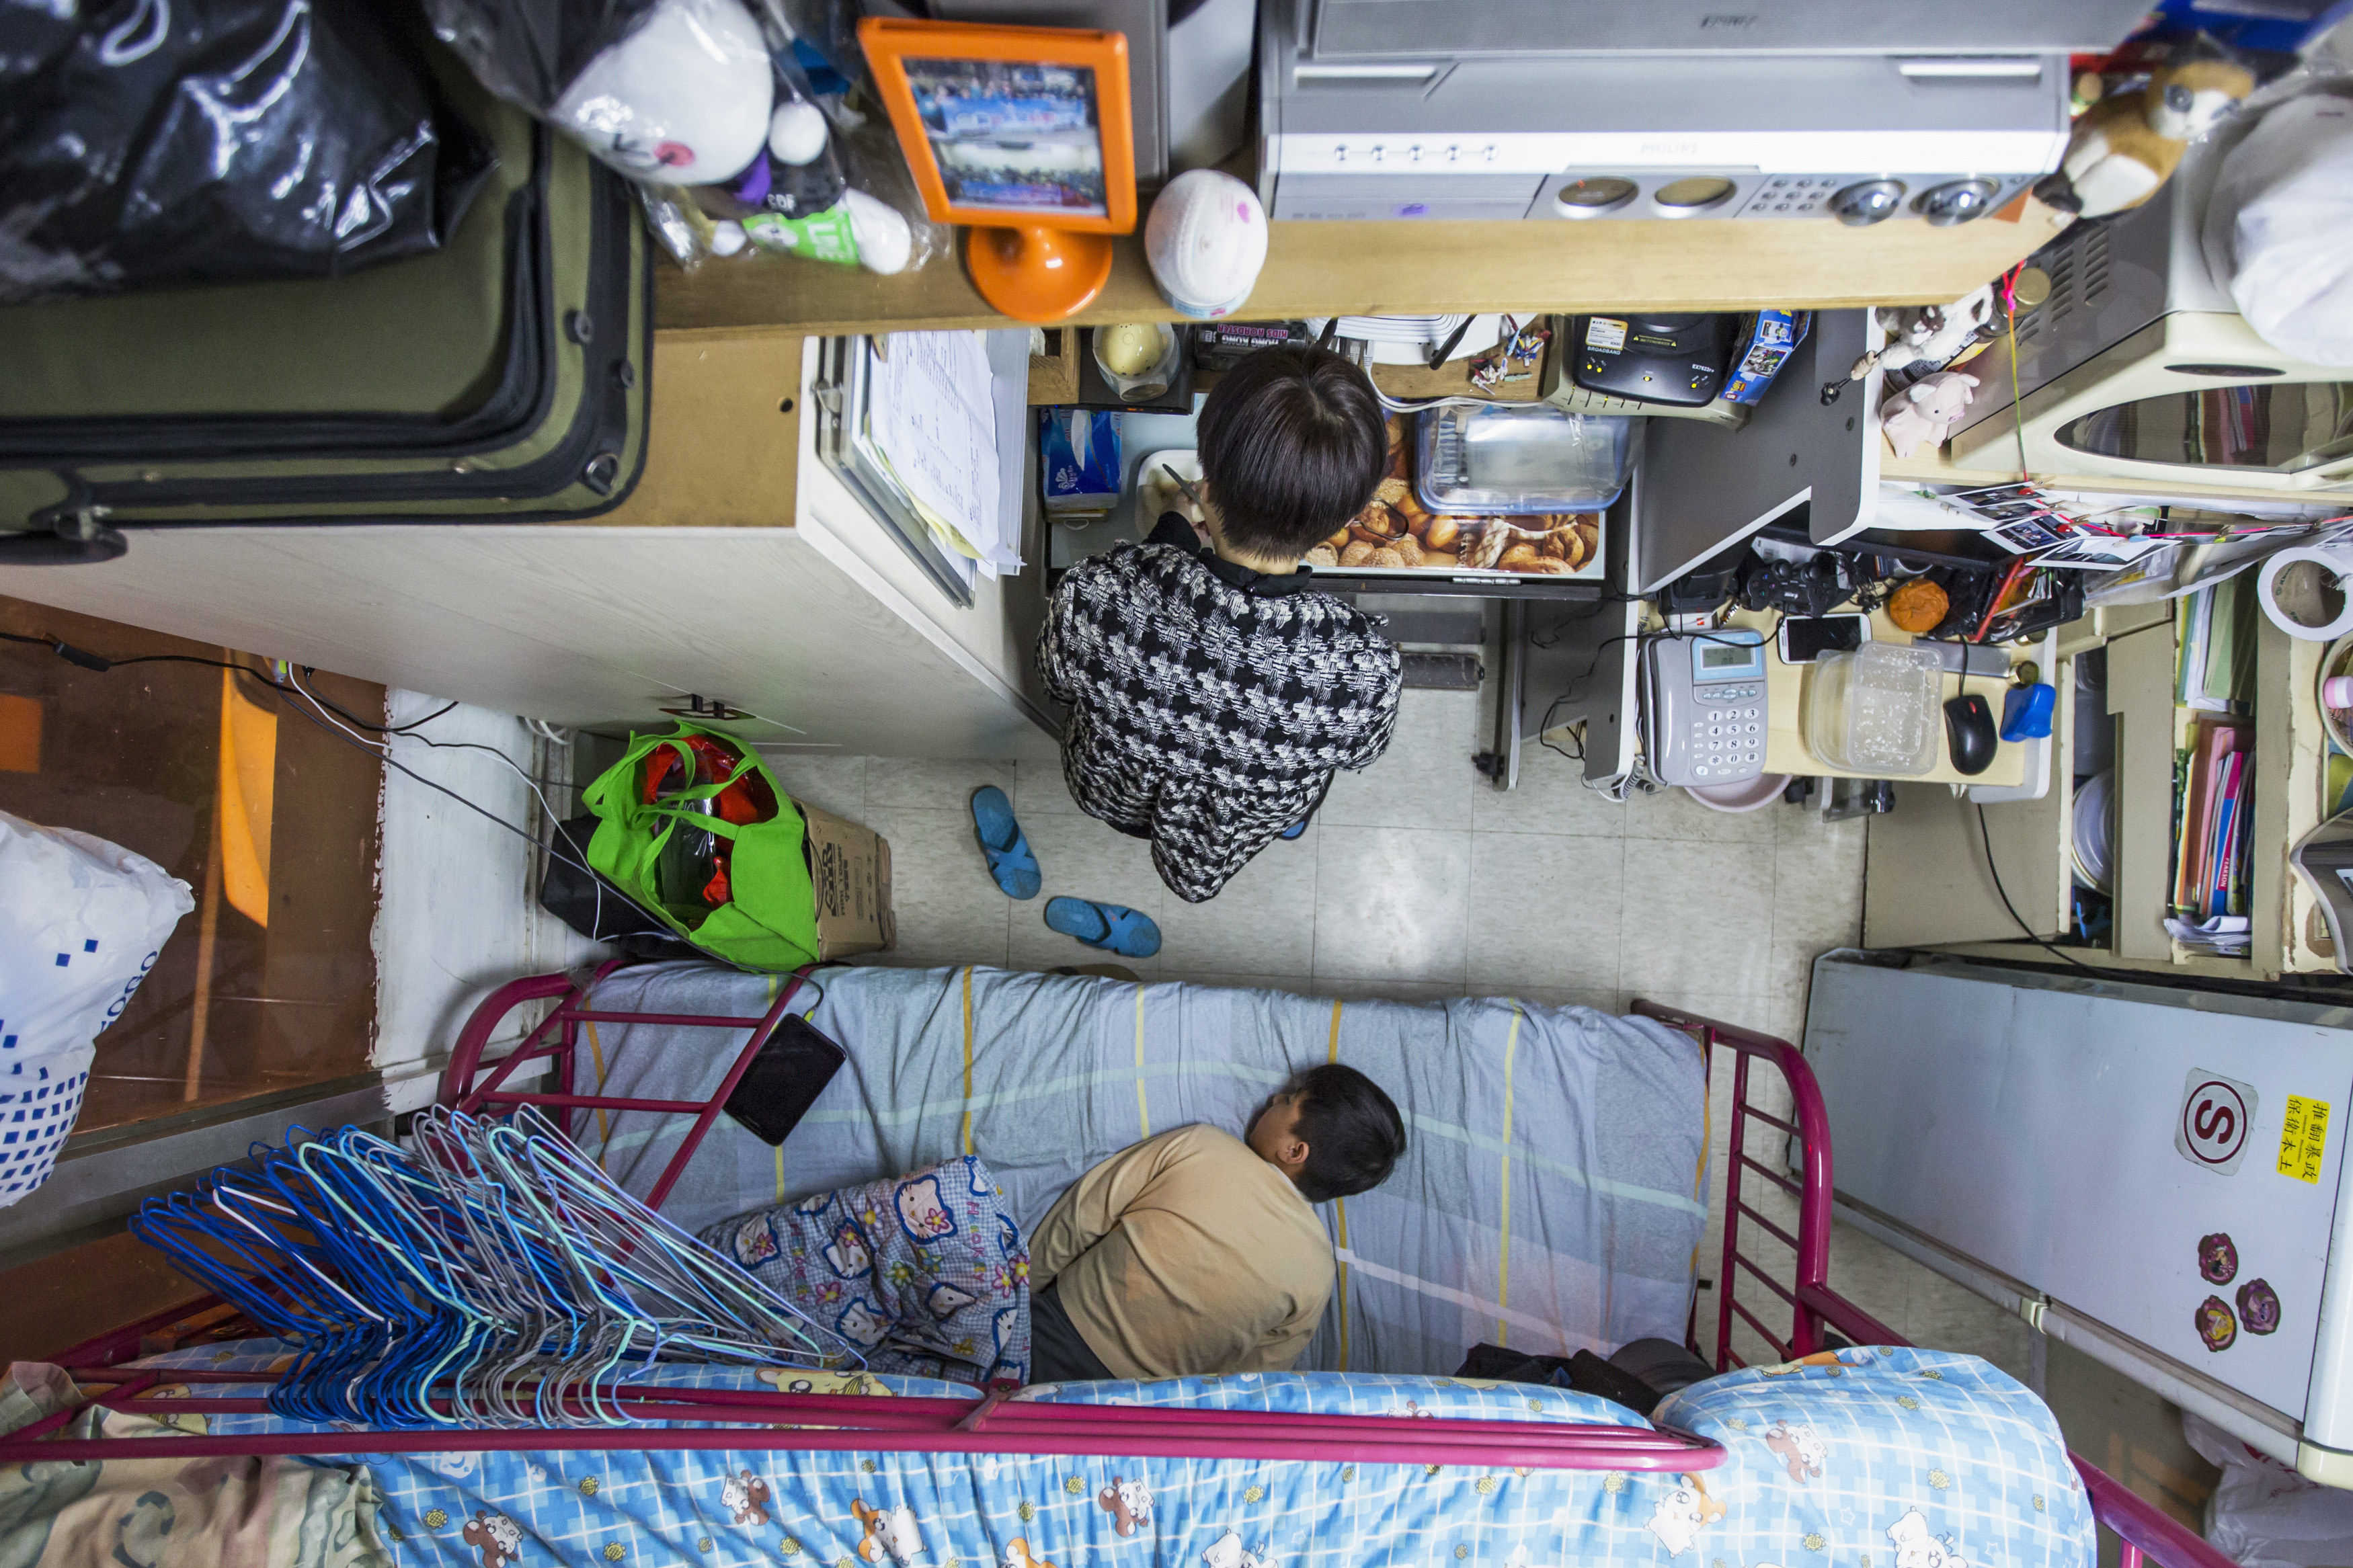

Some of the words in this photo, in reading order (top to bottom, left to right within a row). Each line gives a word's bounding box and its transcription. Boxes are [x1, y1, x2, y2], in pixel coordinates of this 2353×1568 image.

[1640, 142, 1698, 155] PHILIPS
[1218, 323, 1265, 339] ROADSTER
[1267, 328, 1288, 339] KIDS
[1221, 334, 1250, 347] KONG
[1250, 337, 1279, 348] HONG
[1587, 345, 1622, 356] BROADBAND
[1730, 710, 1737, 720] 2
[1749, 709, 1755, 718] 3
[1712, 727, 1718, 735] 4
[1730, 725, 1737, 734] 5
[1749, 724, 1755, 733] 6
[1712, 741, 1718, 750] 7
[1730, 740, 1737, 748] 8
[1749, 738, 1755, 747] 9
[1730, 754, 1737, 763] 0
[2220, 857, 2230, 888] PEARSON
[2194, 1099, 2235, 1145] S
[2280, 1098, 2302, 1171] 保衛本土
[2301, 1103, 2329, 1180] 推翻暴政
